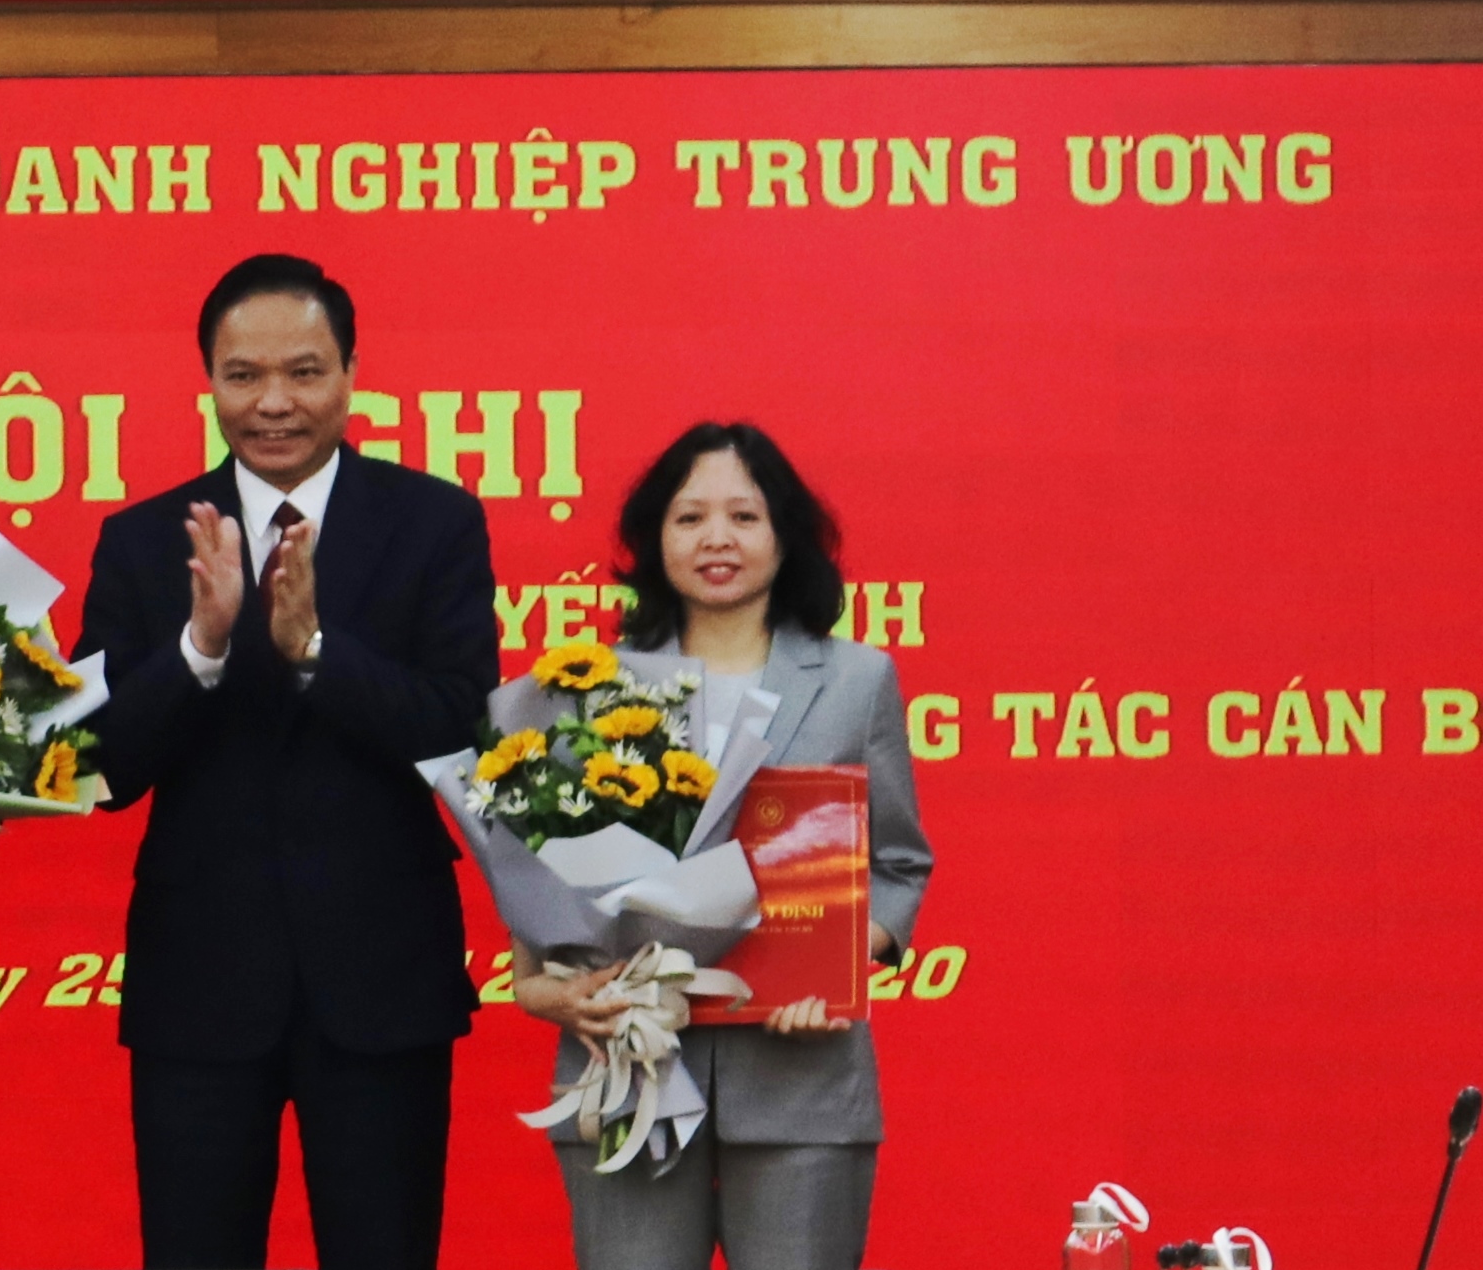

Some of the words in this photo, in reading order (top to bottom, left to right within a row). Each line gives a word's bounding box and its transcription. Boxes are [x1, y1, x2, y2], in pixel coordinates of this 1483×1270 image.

[258, 128, 636, 224] NGHIỆP
[676, 138, 1017, 207] TRUNG
[1066, 132, 1332, 204] ƯƠNG
[197, 390, 582, 521] HỊ
[993, 677, 1170, 759] TÁC
[1207, 675, 1387, 758] CÁN
[868, 944, 968, 1000] 20
